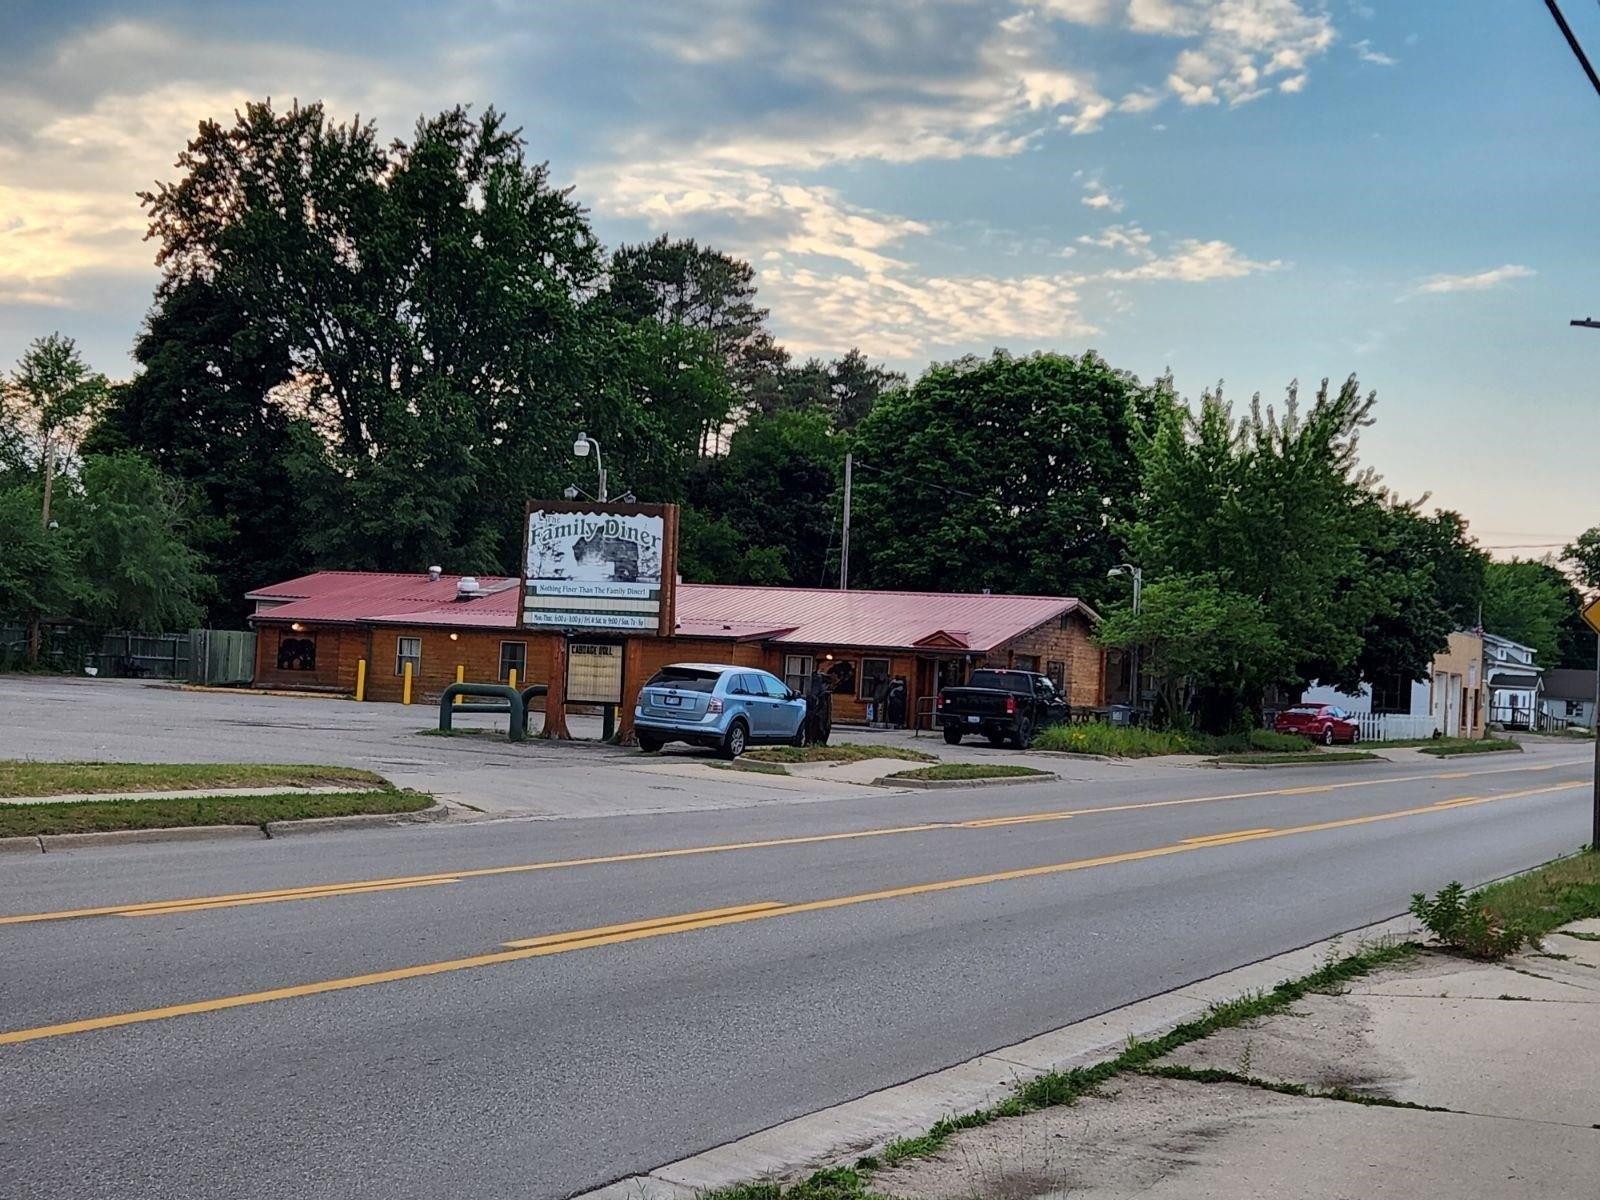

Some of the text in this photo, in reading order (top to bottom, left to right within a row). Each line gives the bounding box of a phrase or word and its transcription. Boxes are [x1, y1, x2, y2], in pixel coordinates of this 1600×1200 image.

[530, 518, 662, 548] Family Diner
[539, 584, 562, 594] Nothing
[579, 586, 594, 594] Than
[594, 586, 605, 594] The
[606, 587, 625, 595] Family
[571, 645, 598, 655] CABBAGE
